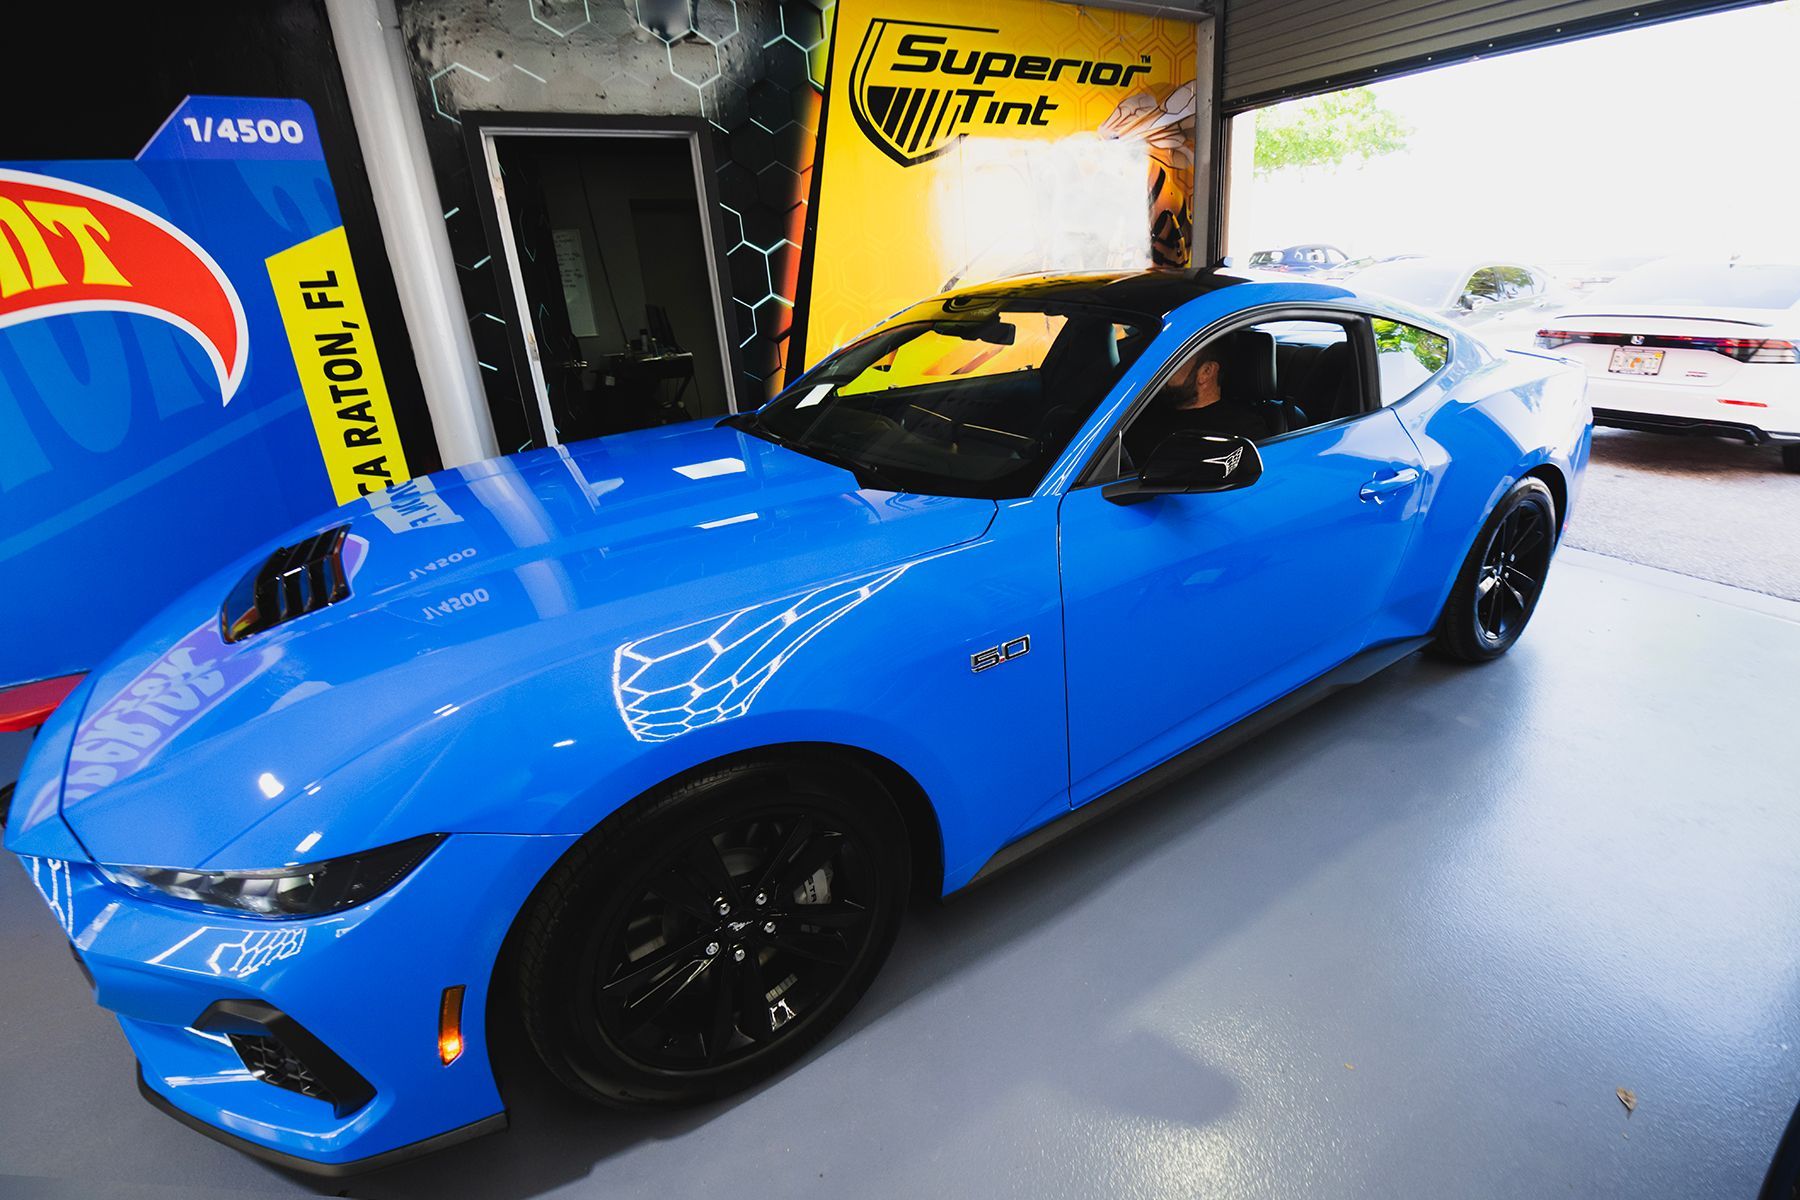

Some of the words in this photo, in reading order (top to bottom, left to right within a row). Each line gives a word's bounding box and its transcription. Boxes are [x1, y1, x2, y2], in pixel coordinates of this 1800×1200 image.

[890, 33, 1152, 87] Superior
[955, 88, 1059, 126] Tint
[183, 116, 304, 144] 1/4500
[299, 270, 344, 310] FL
[314, 320, 382, 448] RATON,
[970, 633, 1031, 673] 5.0
